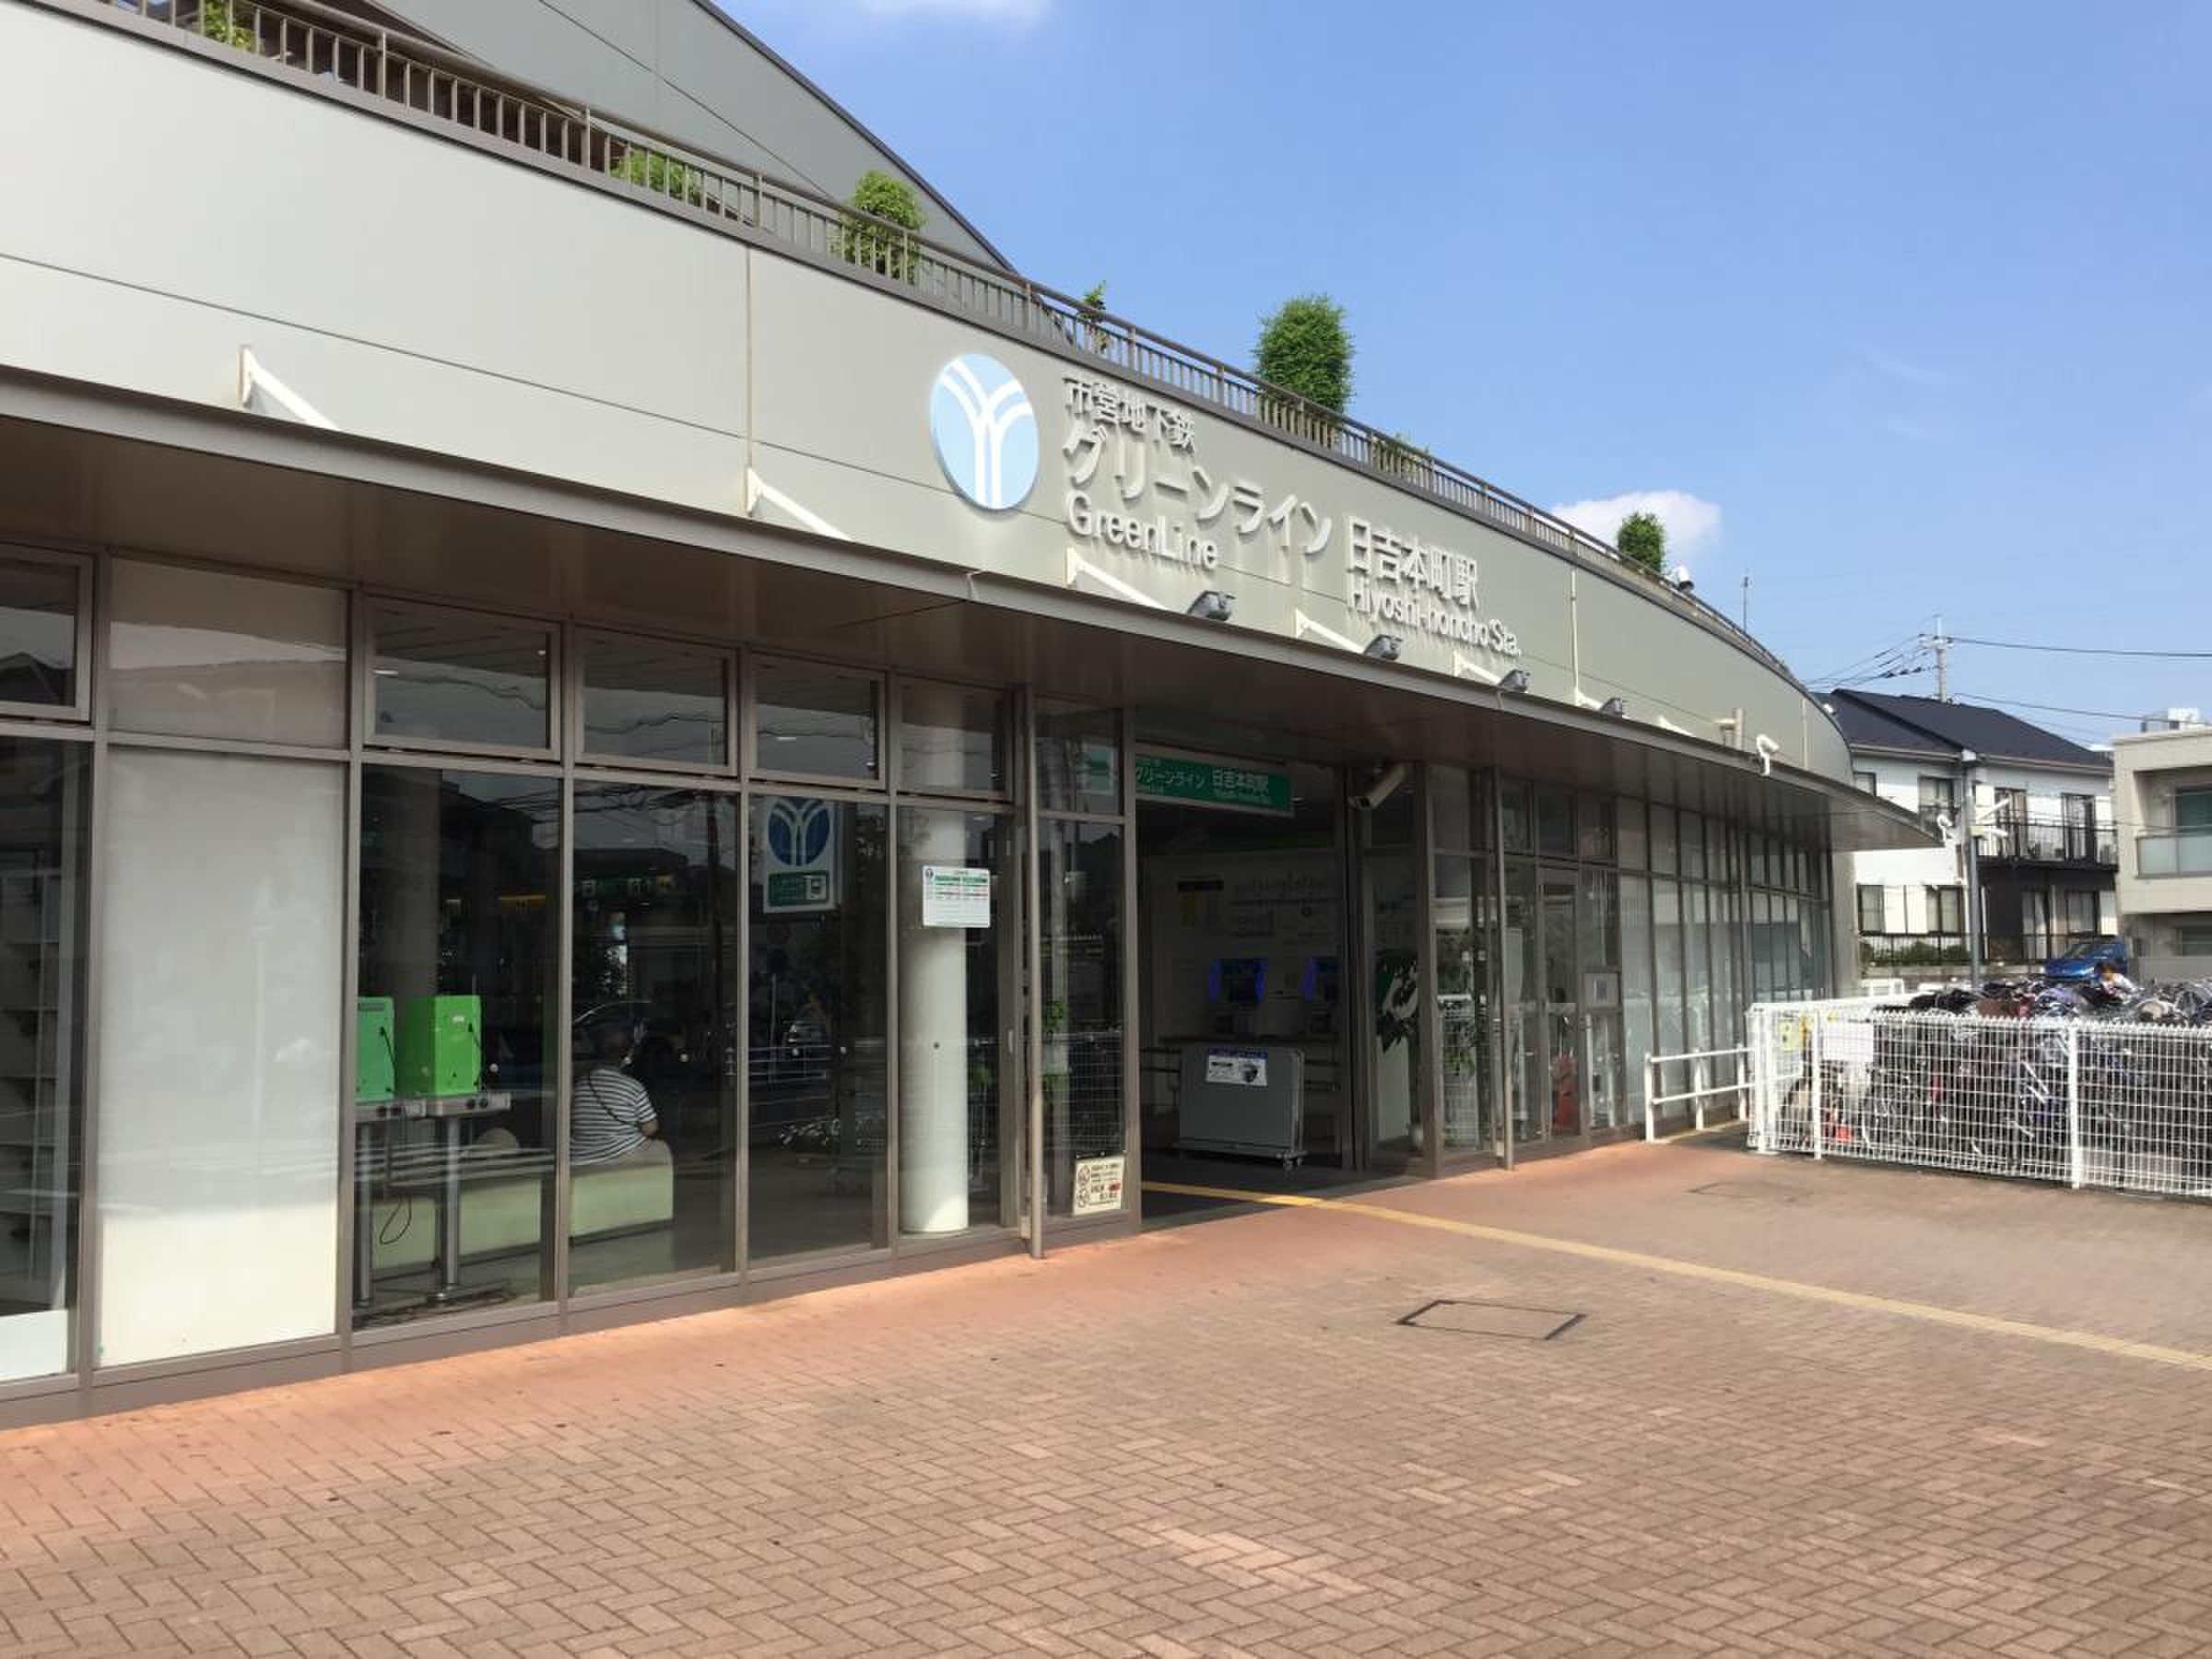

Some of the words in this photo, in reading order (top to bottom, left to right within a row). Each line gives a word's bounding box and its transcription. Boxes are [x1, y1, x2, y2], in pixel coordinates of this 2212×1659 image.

[1062, 376, 1195, 451] 市営地下鉄
[1063, 418, 1333, 558] グリーンライン
[1346, 518, 1479, 608] 日吉本町駅
